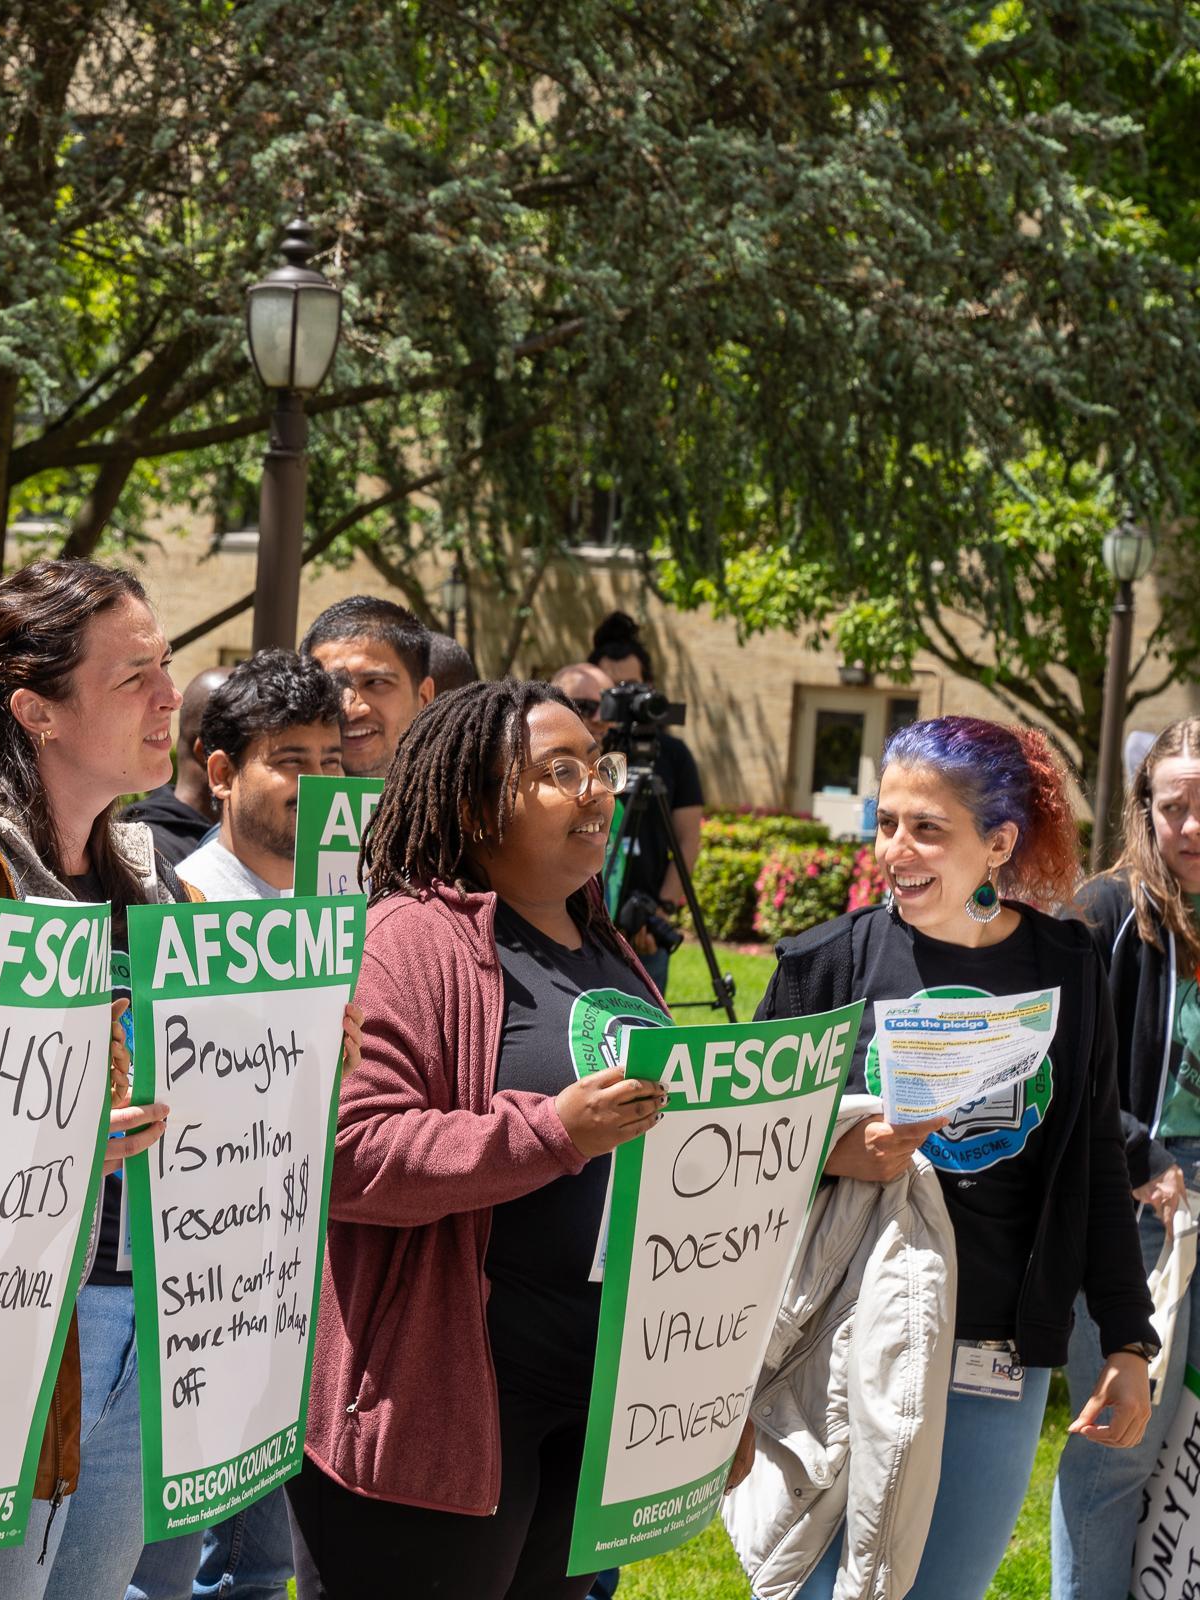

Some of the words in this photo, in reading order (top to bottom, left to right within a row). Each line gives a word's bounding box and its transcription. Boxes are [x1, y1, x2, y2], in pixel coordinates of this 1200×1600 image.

[151, 906, 355, 990] AFSCME
[166, 1015, 304, 1093] Brought
[889, 1019, 919, 1029] Take
[920, 1018, 941, 1029] the
[943, 1018, 985, 1031] pledge
[583, 1043, 600, 1073] HSU
[660, 1021, 851, 1104] AFSCME
[159, 1117, 207, 1179] 1.5
[216, 1119, 292, 1167] million
[672, 1113, 813, 1198] OHSU
[919, 1139, 959, 1161] EGON
[959, 1137, 1012, 1162] AFSCME
[161, 1186, 271, 1243] research
[281, 1154, 309, 1236] $$
[161, 1264, 224, 1316] Still
[231, 1251, 275, 1302] can't
[277, 1246, 302, 1298] get
[166, 1326, 225, 1360] more
[227, 1311, 267, 1342] than
[643, 1304, 758, 1363] VALUE
[625, 1385, 753, 1450] DIVERSIT
[162, 1461, 238, 1511] OREGON
[239, 1435, 282, 1485] COUNCIL
[283, 1426, 298, 1458] 75
[167, 1513, 200, 1529] American
[200, 1502, 227, 1521] Federation
[632, 1495, 683, 1528] OREGON
[686, 1474, 721, 1511] COUNCIL
[595, 1537, 628, 1552] American
[629, 1528, 662, 1543] Federation
[663, 1523, 670, 1535] of
[1139, 1485, 1191, 1600] ONLY
